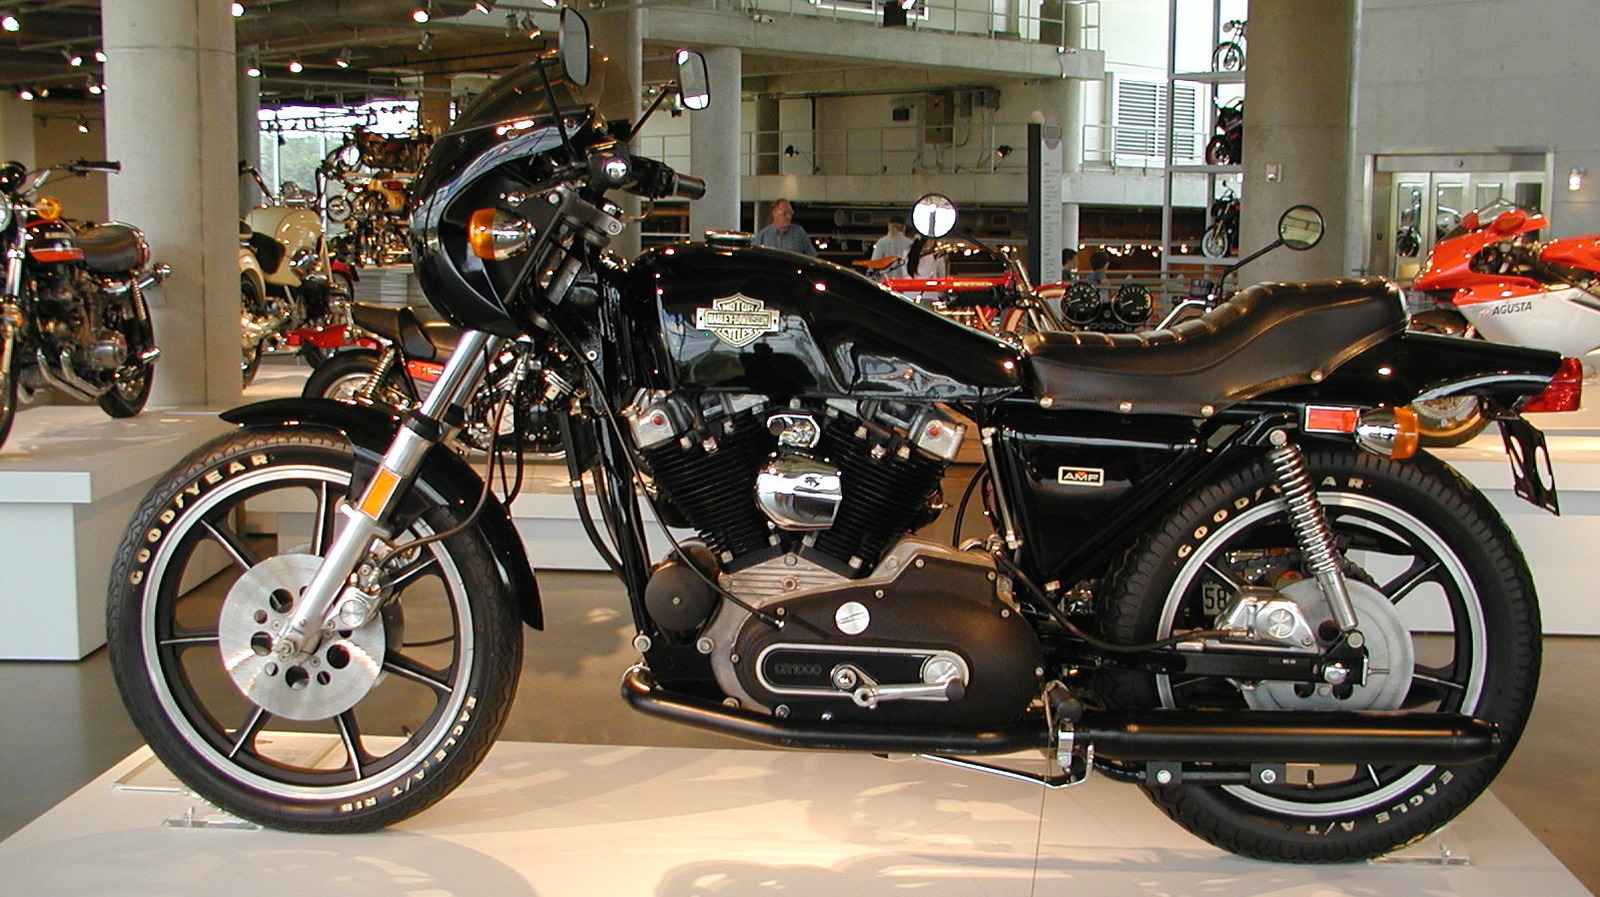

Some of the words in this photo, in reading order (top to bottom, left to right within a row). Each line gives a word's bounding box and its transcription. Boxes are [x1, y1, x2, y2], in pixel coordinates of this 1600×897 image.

[722, 299, 755, 311] MOTOR
[1492, 301, 1532, 316] AGUSTA
[721, 328, 754, 341] CYCLES
[1063, 471, 1099, 482] AMF
[1177, 475, 1364, 558] GOODYAR
[435, 696, 477, 763] EAGLE
[391, 769, 426, 797] A/T
[340, 797, 377, 813] RIB
[1375, 770, 1455, 824] EAGLE
[1306, 820, 1355, 836] A/T
